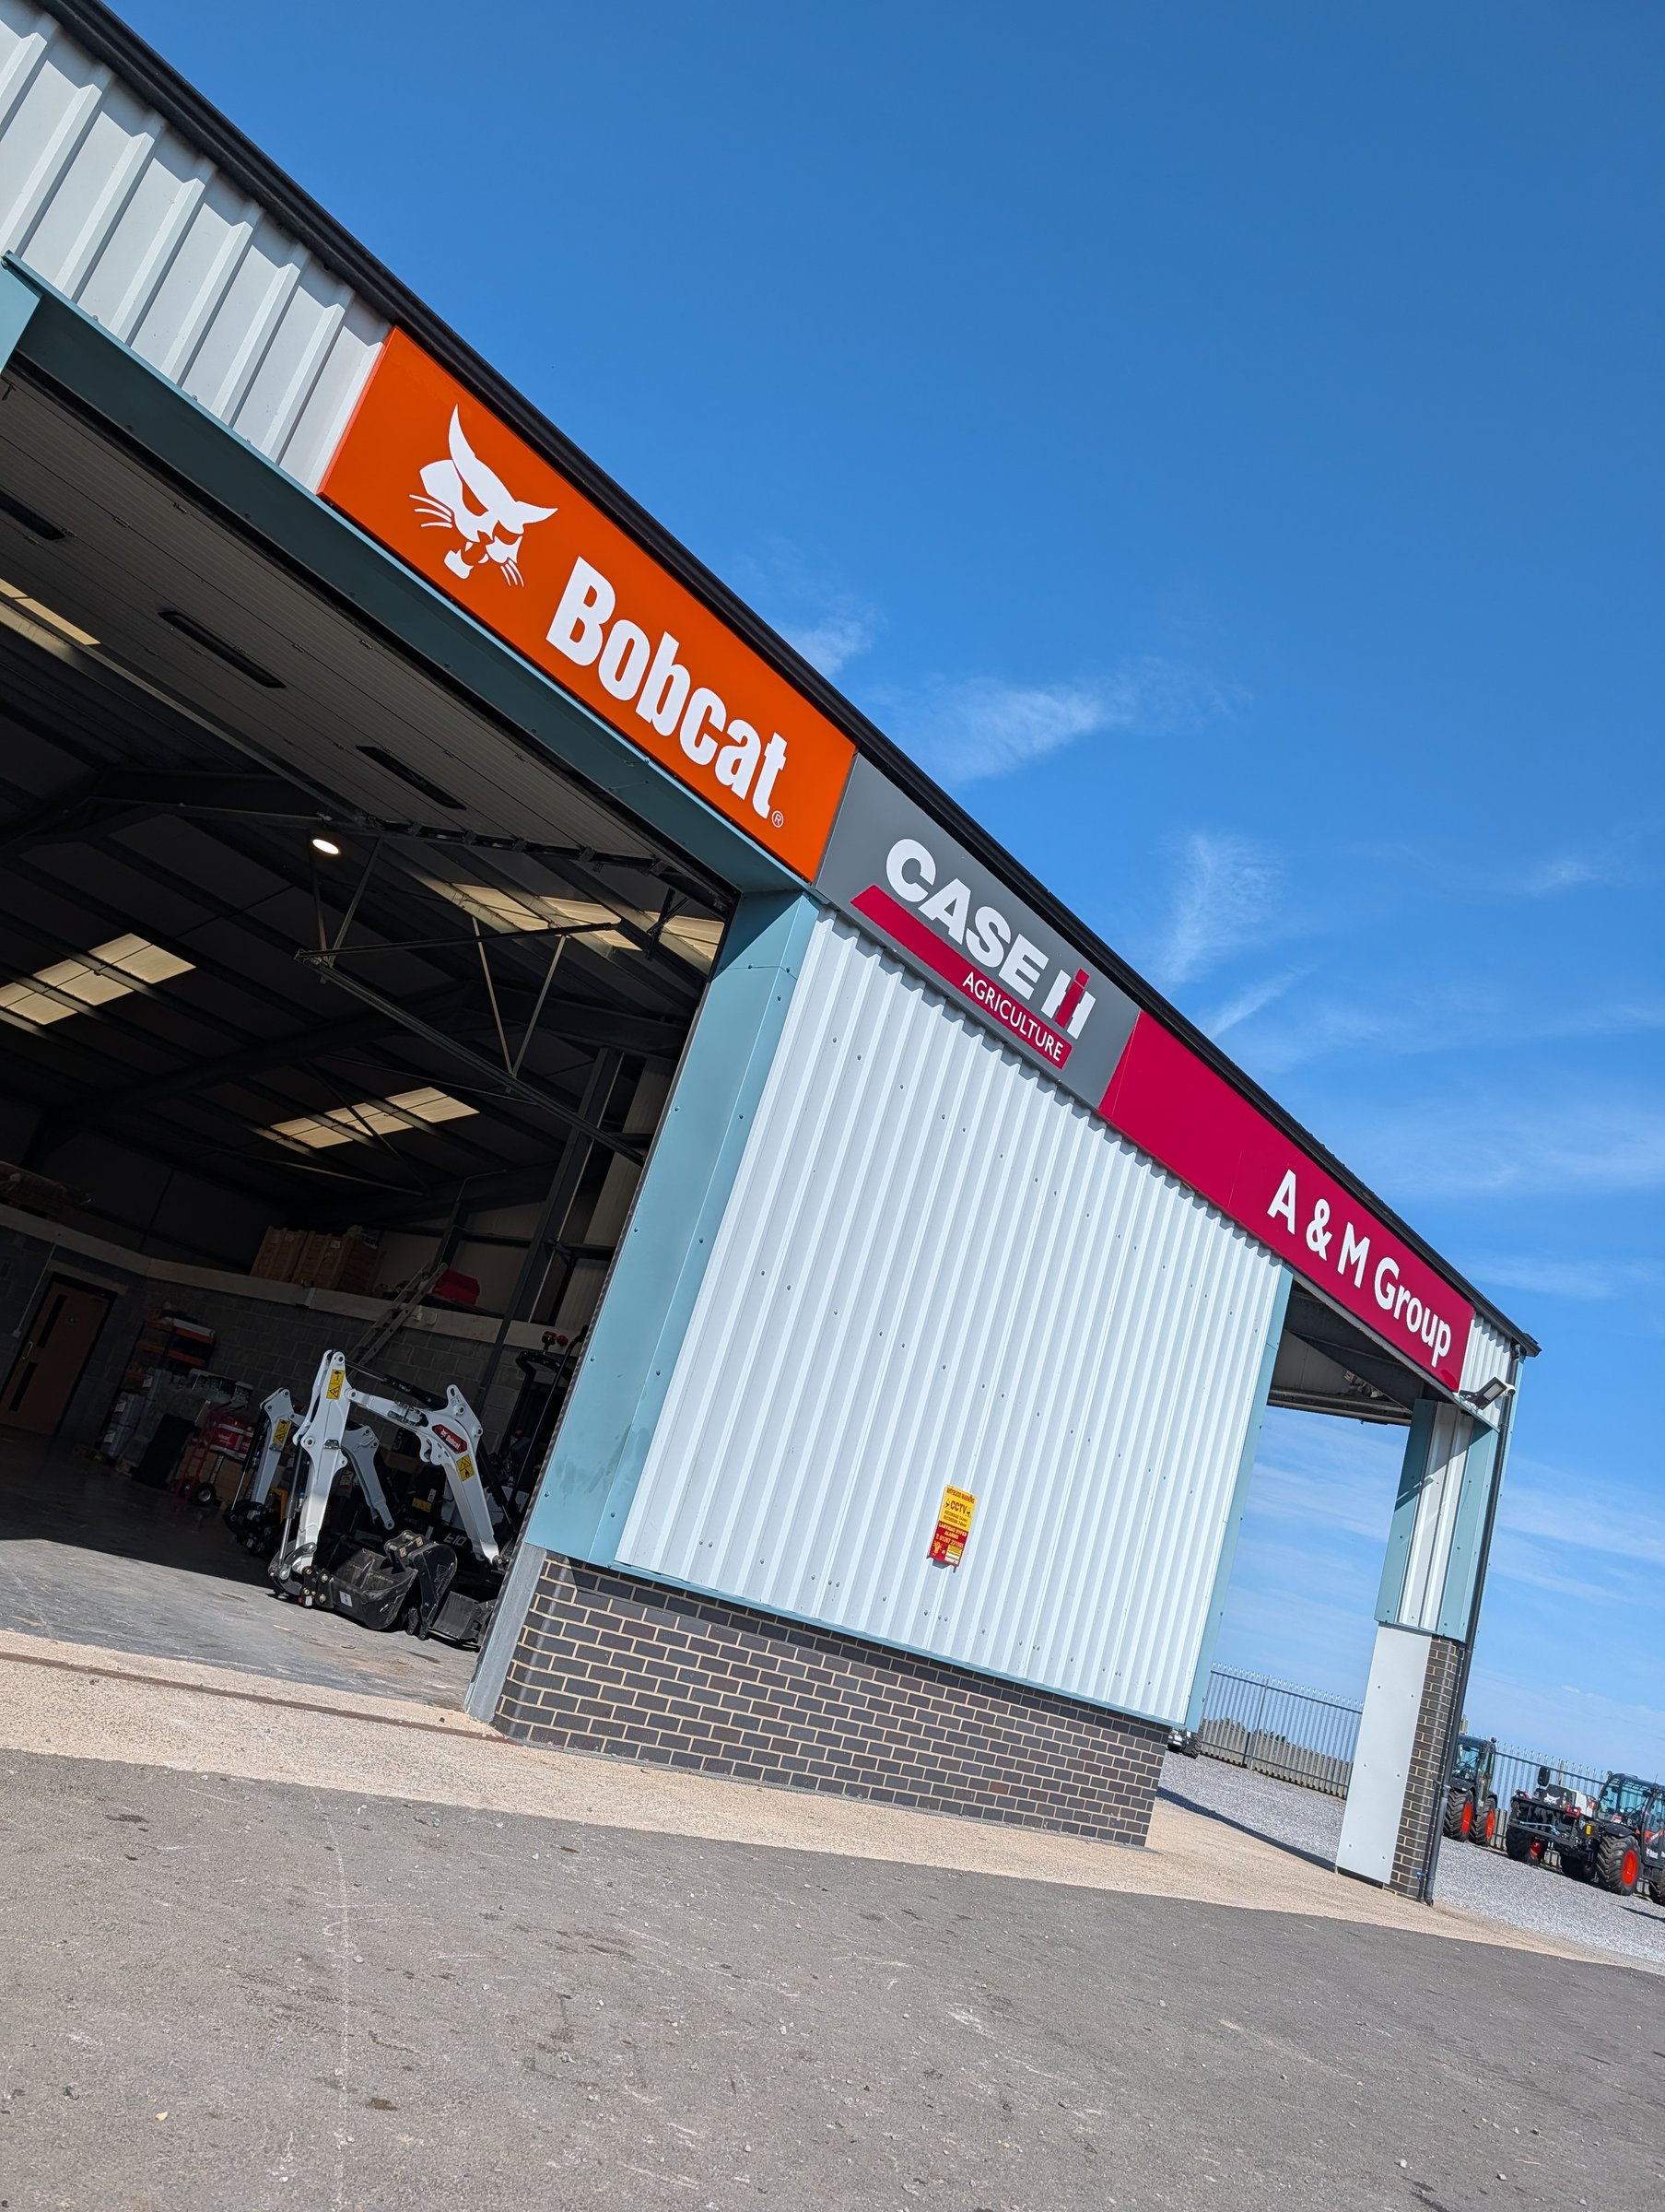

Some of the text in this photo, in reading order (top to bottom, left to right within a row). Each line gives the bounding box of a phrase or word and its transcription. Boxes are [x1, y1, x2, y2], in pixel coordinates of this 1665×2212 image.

[545, 555, 788, 818] Bobcat
[885, 838, 1049, 1001] CASE
[962, 971, 1064, 1062] AGRICULTURE
[1266, 1169, 1452, 1368] A & M Group
[950, 1500, 967, 1514] CCTV
